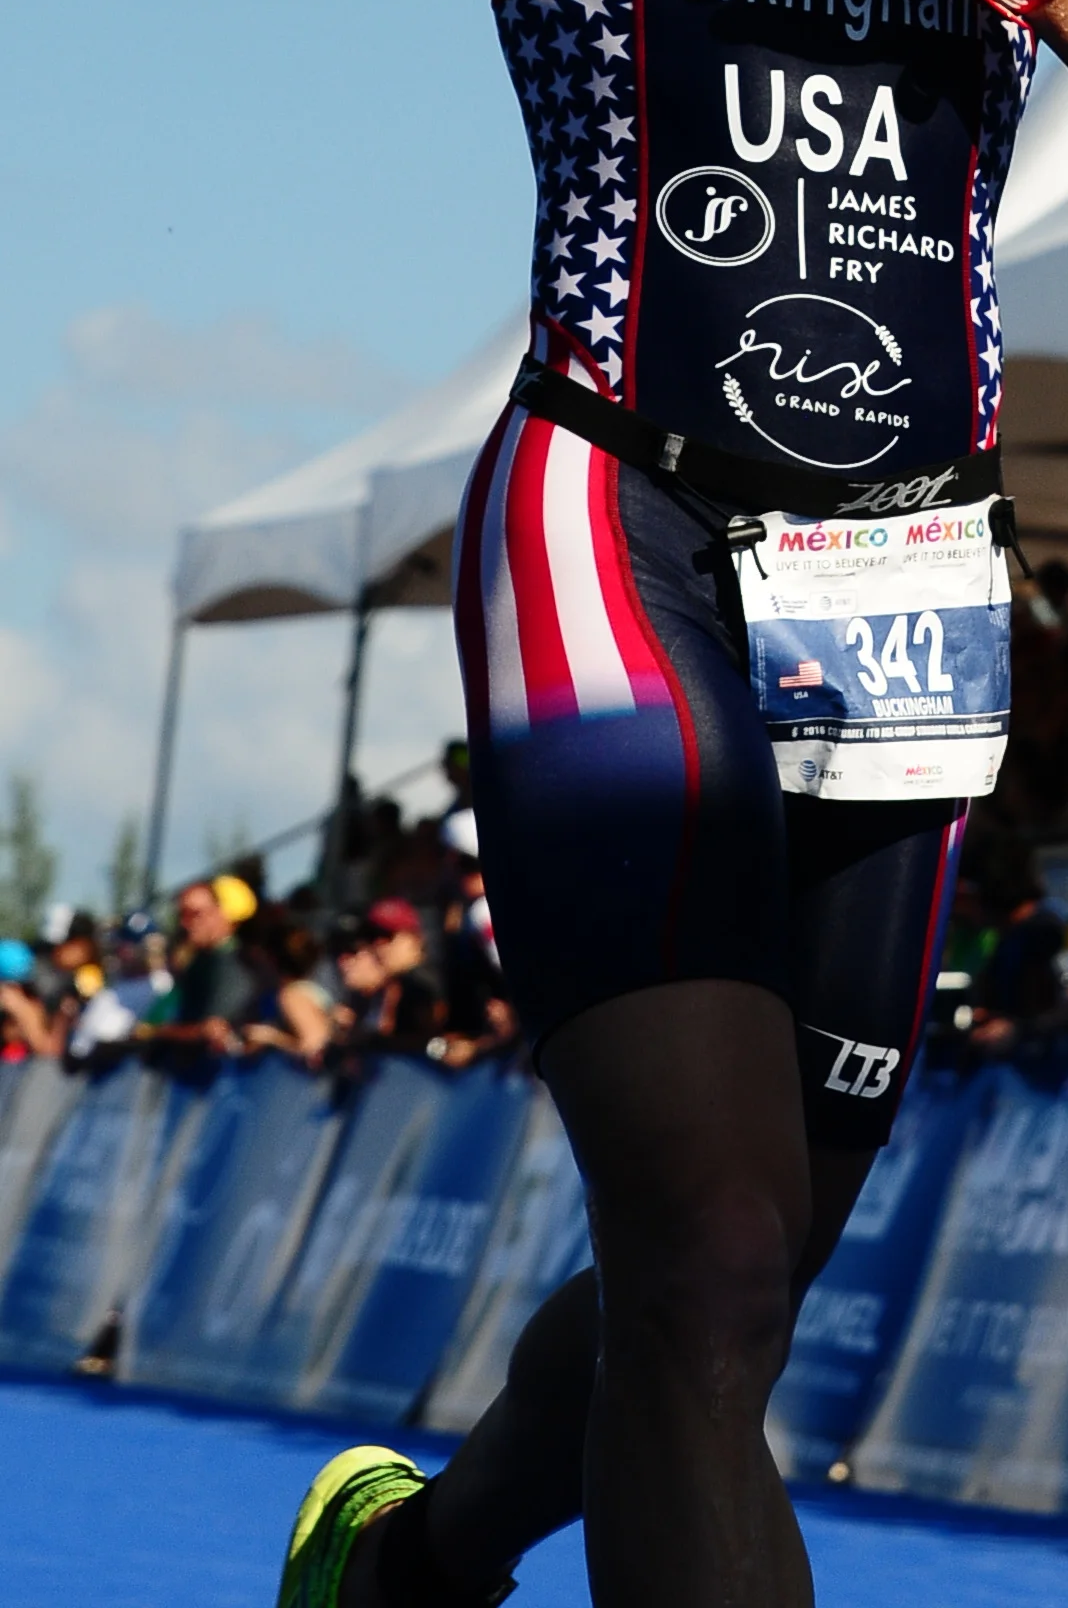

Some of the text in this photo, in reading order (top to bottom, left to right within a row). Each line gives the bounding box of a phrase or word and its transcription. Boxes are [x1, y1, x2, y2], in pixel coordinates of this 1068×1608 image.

[724, 63, 909, 182] USA
[827, 187, 917, 221] JAMES
[828, 222, 955, 263] RICHARD
[829, 257, 884, 284] FRY
[775, 393, 910, 429] GRAND RAPIDS
[776, 560, 799, 572] LIVE
[803, 560, 812, 570] IT
[817, 559, 831, 570] TO
[835, 557, 876, 569] BELIEVE
[846, 610, 954, 696] 342
[793, 691, 809, 700] USA
[872, 695, 955, 718] BUCKINGHAM
[803, 725, 826, 736] 2016
[819, 768, 843, 781] AT&T
